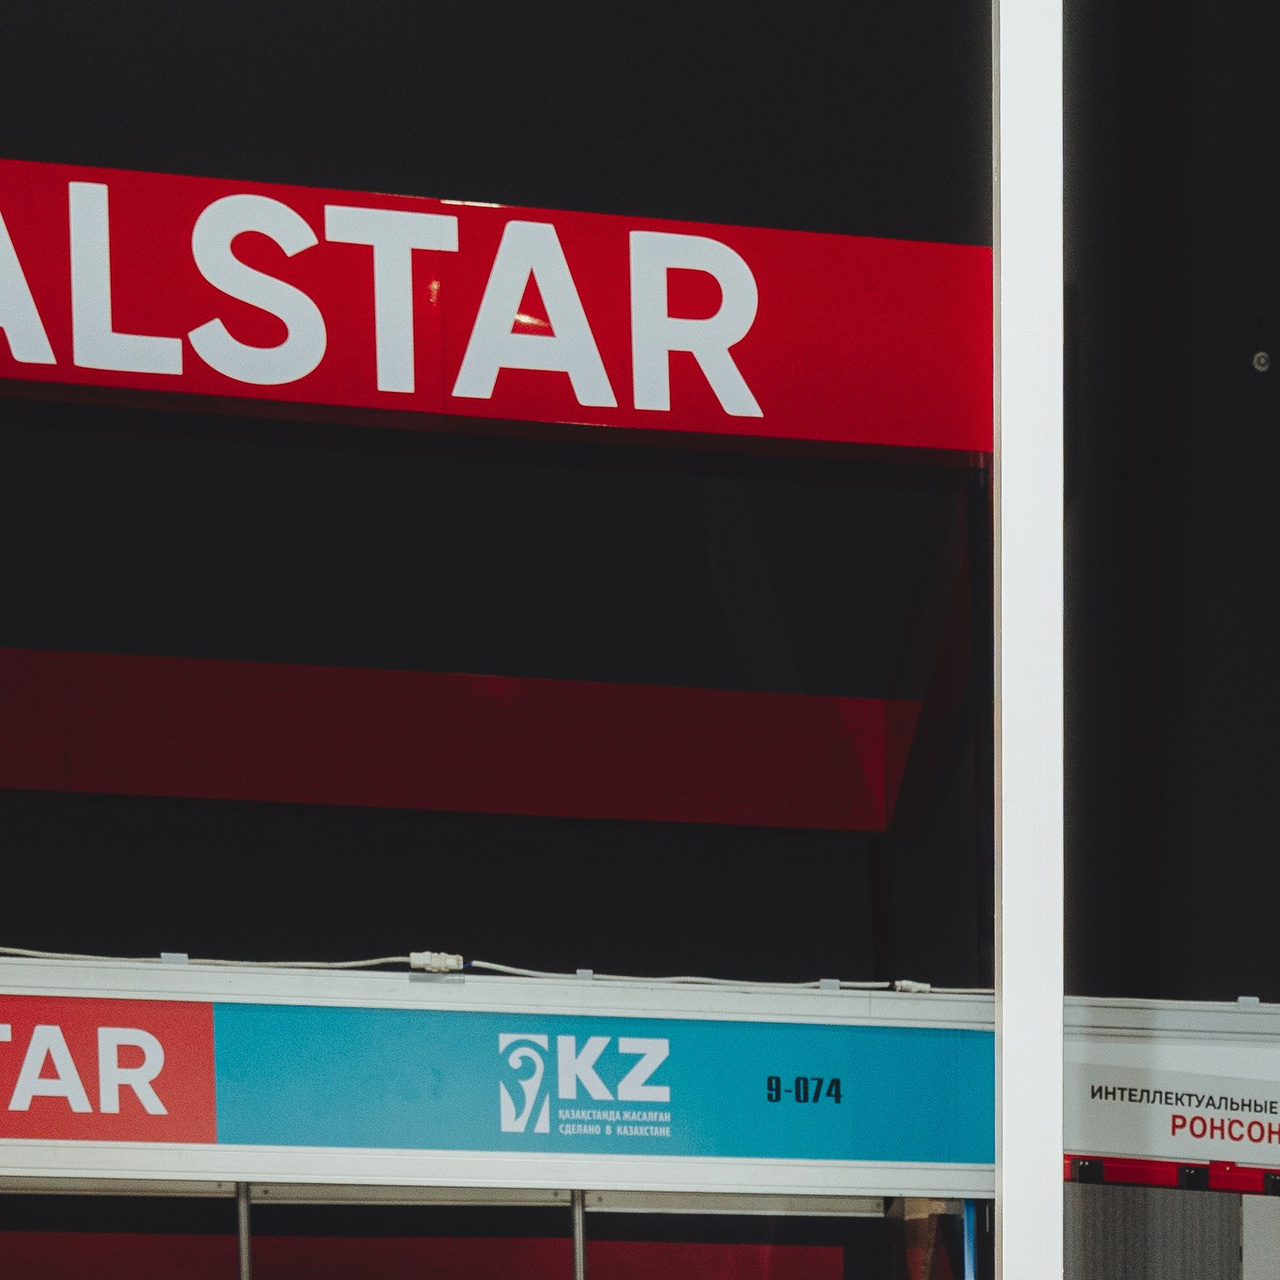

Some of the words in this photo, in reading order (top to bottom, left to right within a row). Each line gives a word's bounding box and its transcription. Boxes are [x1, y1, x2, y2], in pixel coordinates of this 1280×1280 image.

[556, 1035, 670, 1102] KZ
[766, 1076, 842, 1104] 9-074
[1090, 1085, 1278, 1116] ИНТЕЛЛЕКТУАЛЬНЫЕ
[559, 1122, 601, 1136] СДЕЛАНО
[605, 1124, 613, 1136] В
[617, 1125, 671, 1137] КАЗАХСТАНЕ
